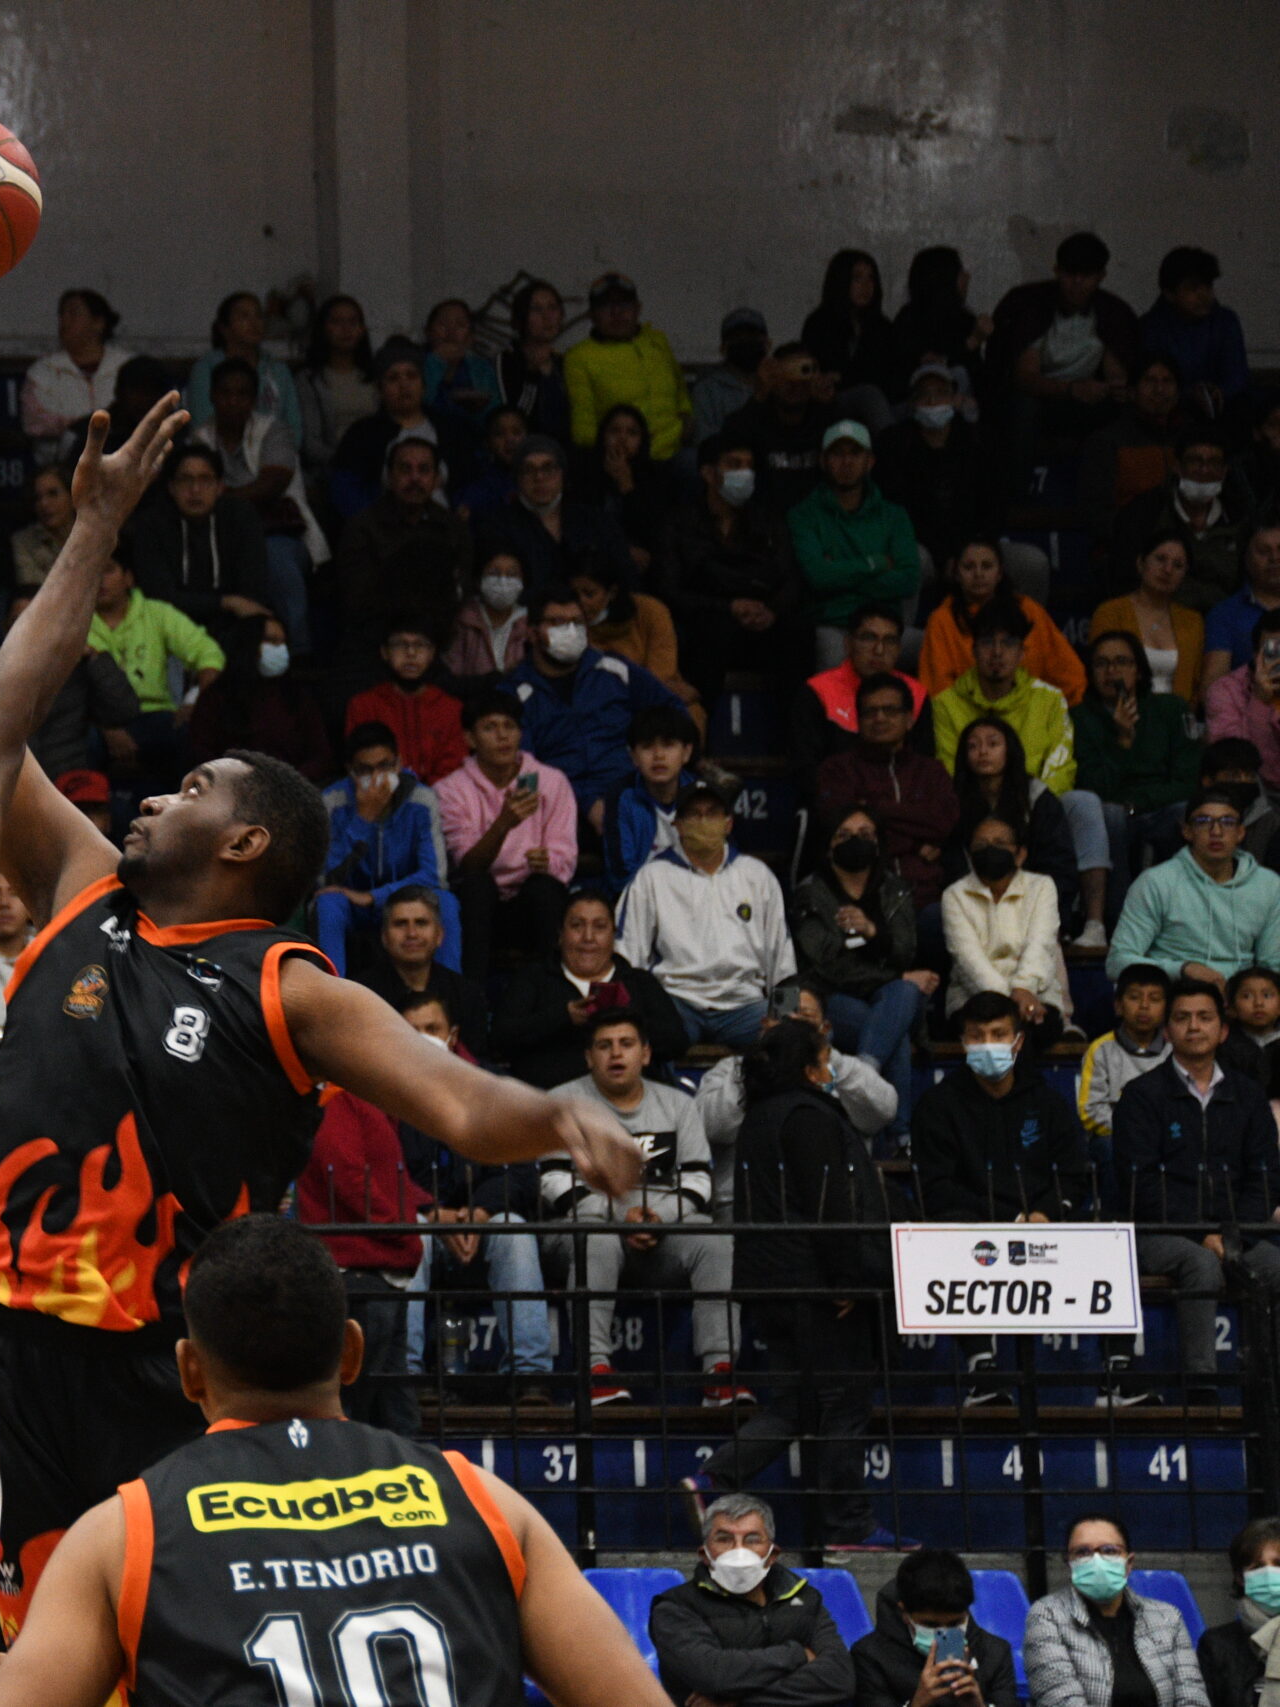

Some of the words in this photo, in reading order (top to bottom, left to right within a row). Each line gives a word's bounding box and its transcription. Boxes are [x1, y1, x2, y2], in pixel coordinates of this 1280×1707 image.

[733, 788, 769, 820] 42
[162, 1005, 212, 1064] 8
[925, 1280, 1053, 1315] SECTOR
[1089, 1280, 1113, 1315] B
[541, 1443, 578, 1483] 37
[1148, 1444, 1189, 1483] 41
[198, 1473, 431, 1522] Ecuabet
[389, 1510, 436, 1523] .com
[228, 1542, 439, 1592] E.TENORIO
[243, 1602, 458, 1707] 10
